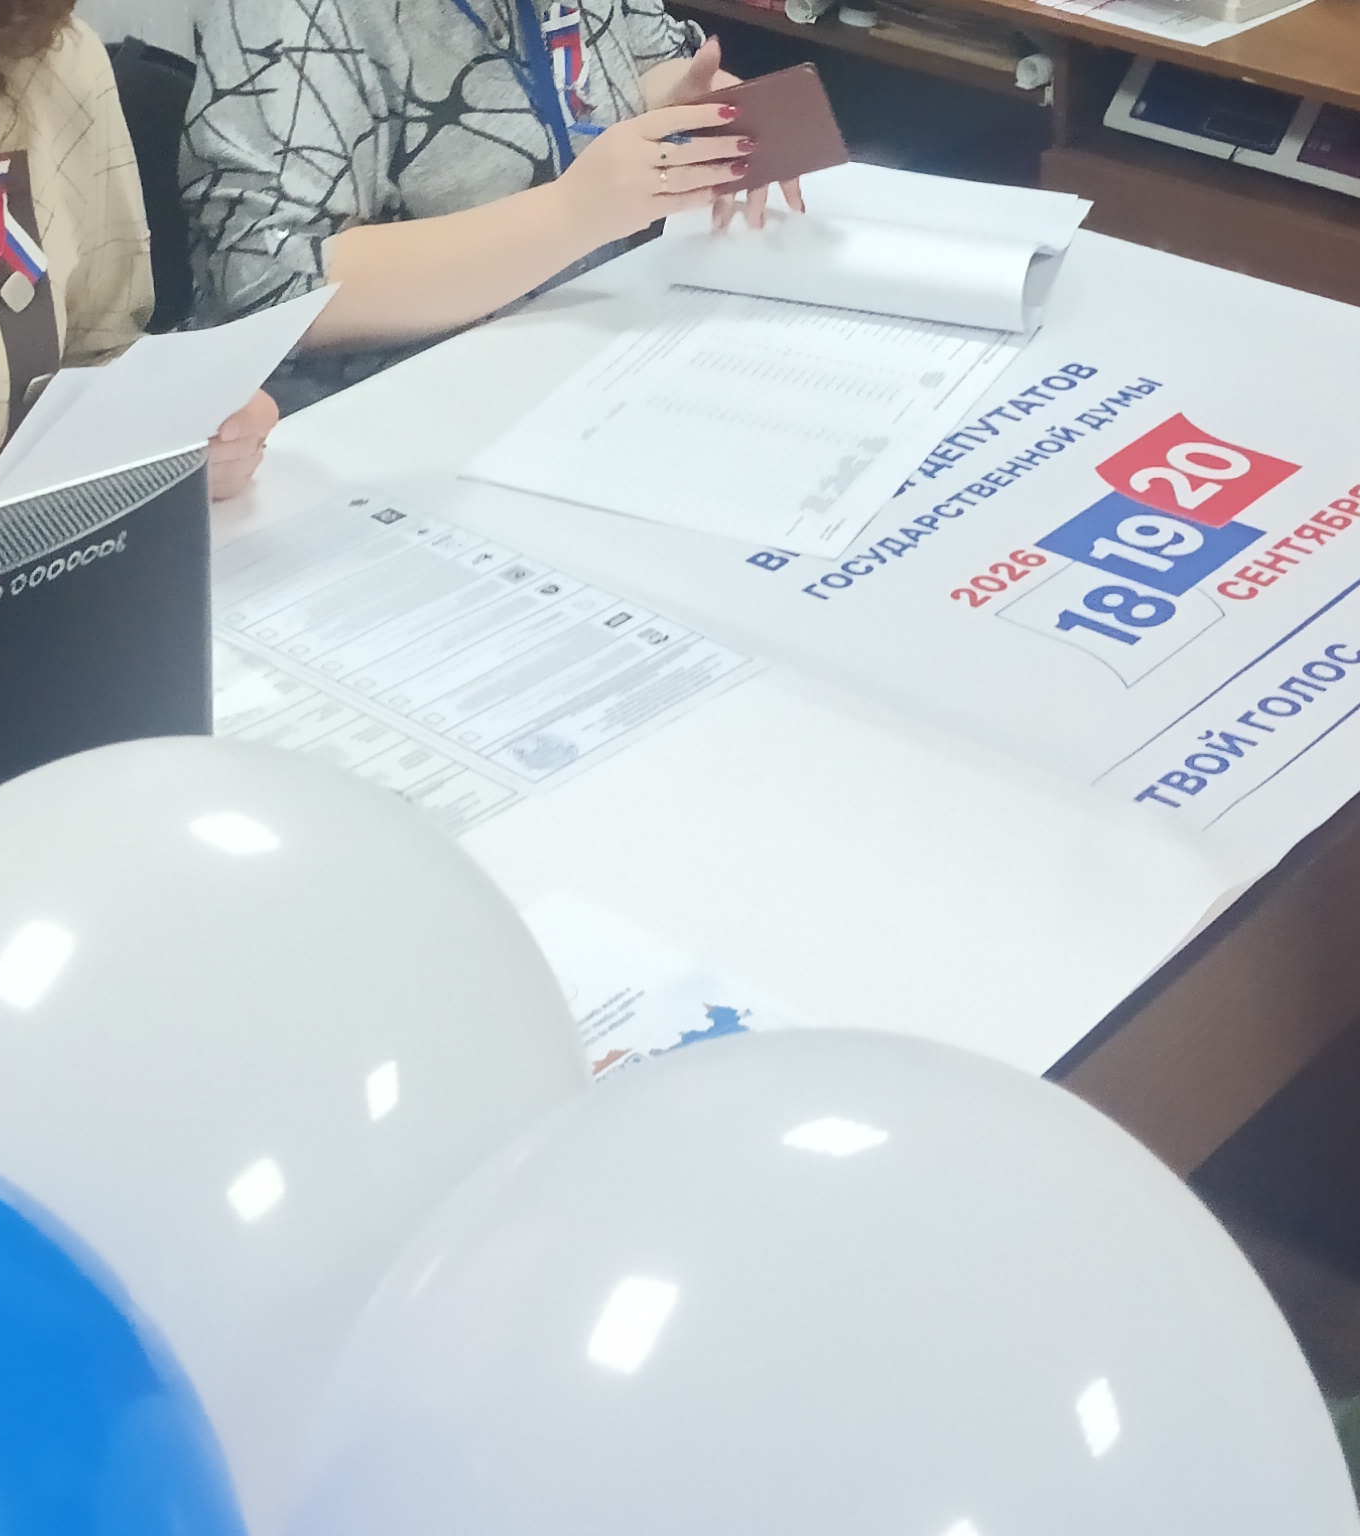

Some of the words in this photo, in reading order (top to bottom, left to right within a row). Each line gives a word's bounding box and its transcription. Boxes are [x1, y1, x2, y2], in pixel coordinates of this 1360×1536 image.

[802, 425, 1085, 600] ГОСУДАРСТВЕННОЙ
[1075, 376, 1164, 431] ДУМЫ
[1129, 442, 1251, 511] 20
[1090, 514, 1204, 573] 19
[950, 549, 1047, 608] 2026
[1055, 585, 1177, 646] 18
[1134, 729, 1258, 809] ТВОЙ
